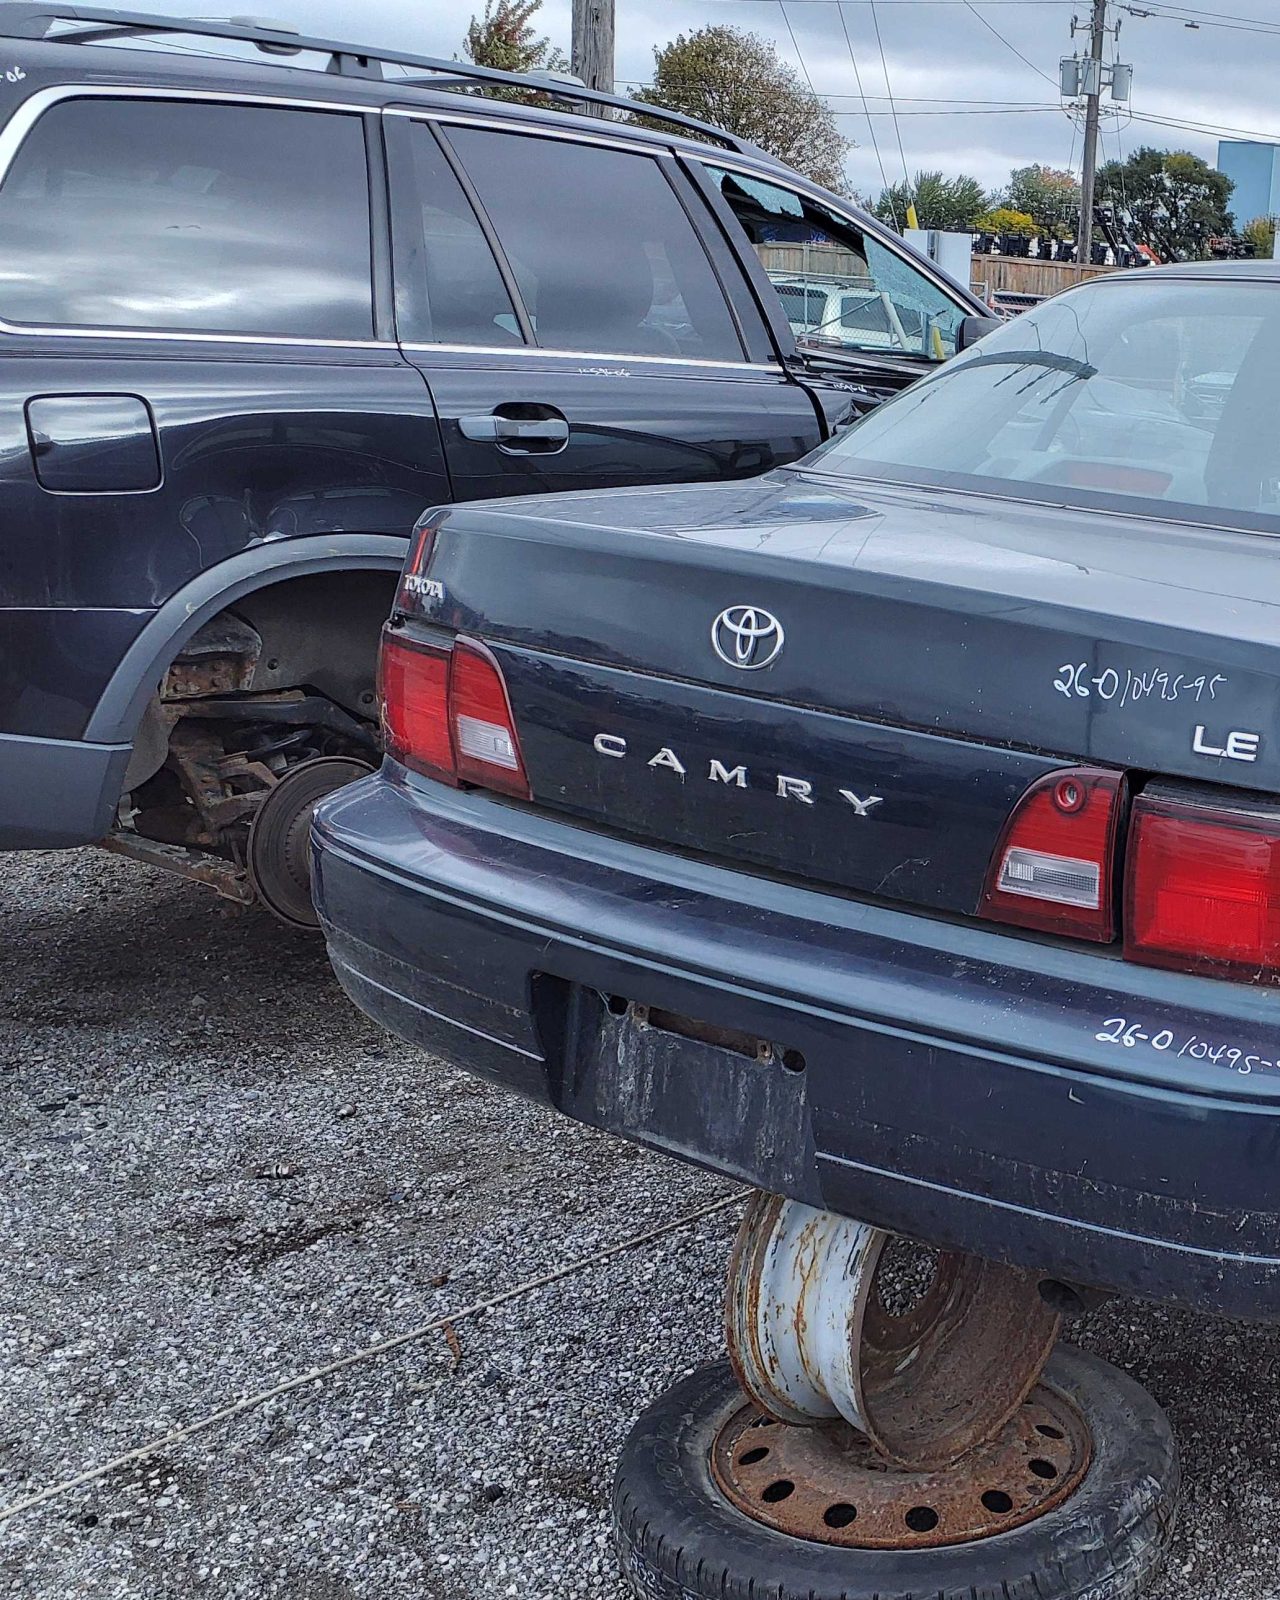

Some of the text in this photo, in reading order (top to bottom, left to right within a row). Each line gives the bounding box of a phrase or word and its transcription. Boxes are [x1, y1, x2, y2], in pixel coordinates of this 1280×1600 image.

[404, 574, 444, 600] TOYOTA
[1053, 662, 1228, 707] 26-010495-95
[1193, 725, 1260, 762] LE
[593, 733, 884, 817] CAMRY
